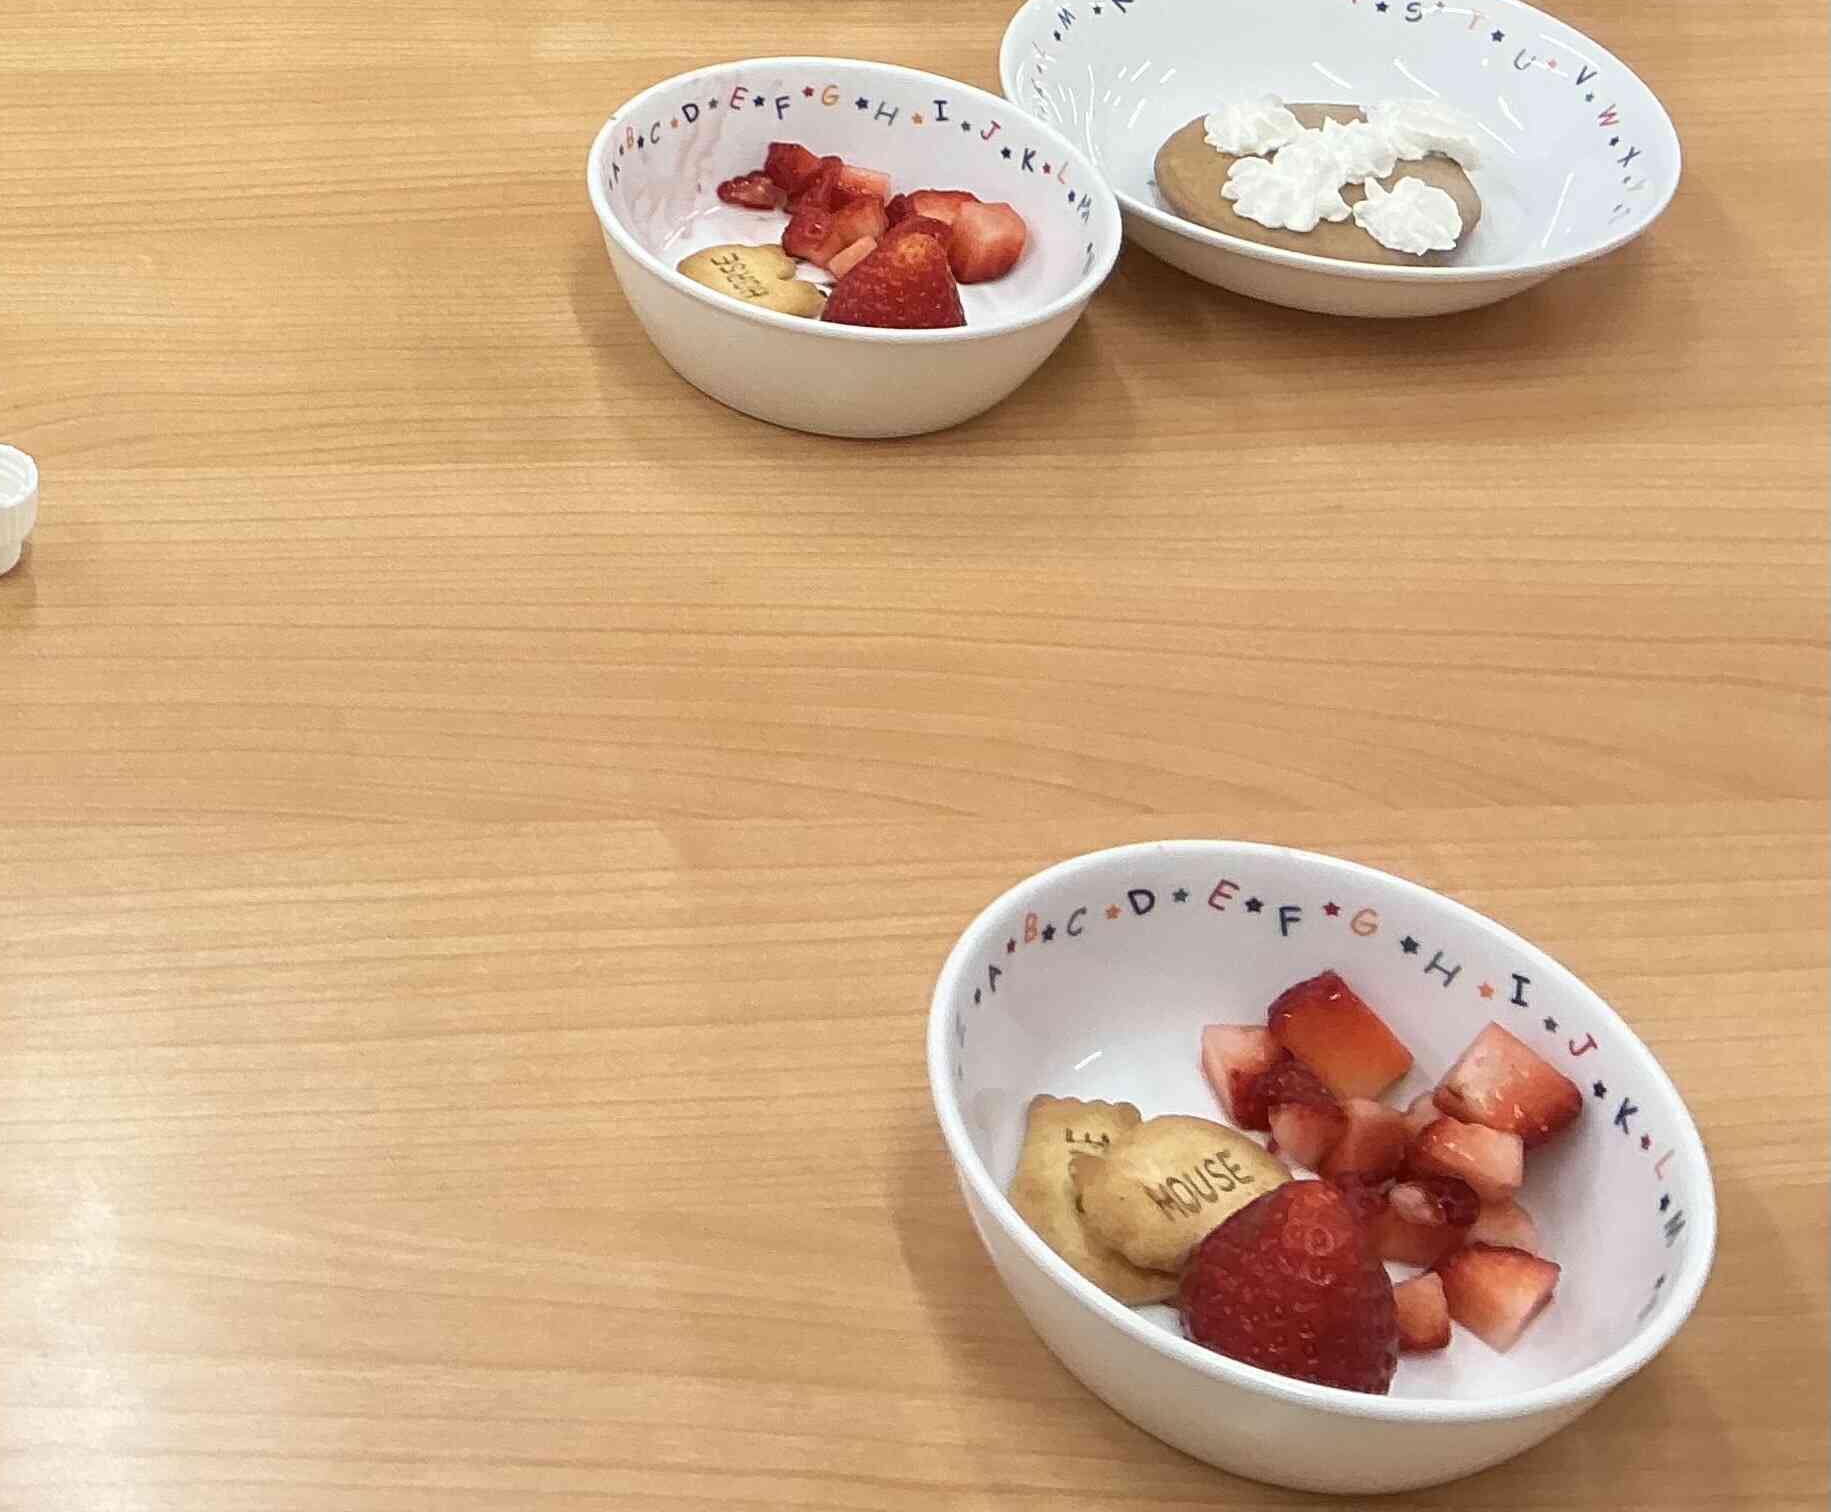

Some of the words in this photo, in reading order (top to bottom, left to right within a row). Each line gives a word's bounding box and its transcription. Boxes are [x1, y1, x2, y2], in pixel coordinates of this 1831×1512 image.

[650, 121, 661, 144] C
[681, 103, 700, 123] D
[731, 87, 748, 109] E
[775, 96, 791, 120] F
[822, 85, 839, 105] G
[875, 102, 899, 126] H
[934, 100, 948, 121] I
[981, 121, 1002, 141] J
[1022, 148, 1036, 173] K
[1404, 2, 1423, 21] S
[1577, 65, 1598, 85] V
[1598, 104, 1619, 127] W
[1618, 147, 1641, 168] X
[1025, 912, 1038, 943] B
[1067, 907, 1087, 936] C
[1128, 888, 1156, 916] D
[1209, 880, 1239, 910] E
[1279, 907, 1301, 936] F
[1350, 909, 1379, 936] G
[1424, 952, 1461, 987] H
[1509, 973, 1532, 1007] I
[1569, 1033, 1597, 1056] J
[1614, 1097, 1638, 1134] K
[1140, 1149, 1254, 1221] MOUSE
